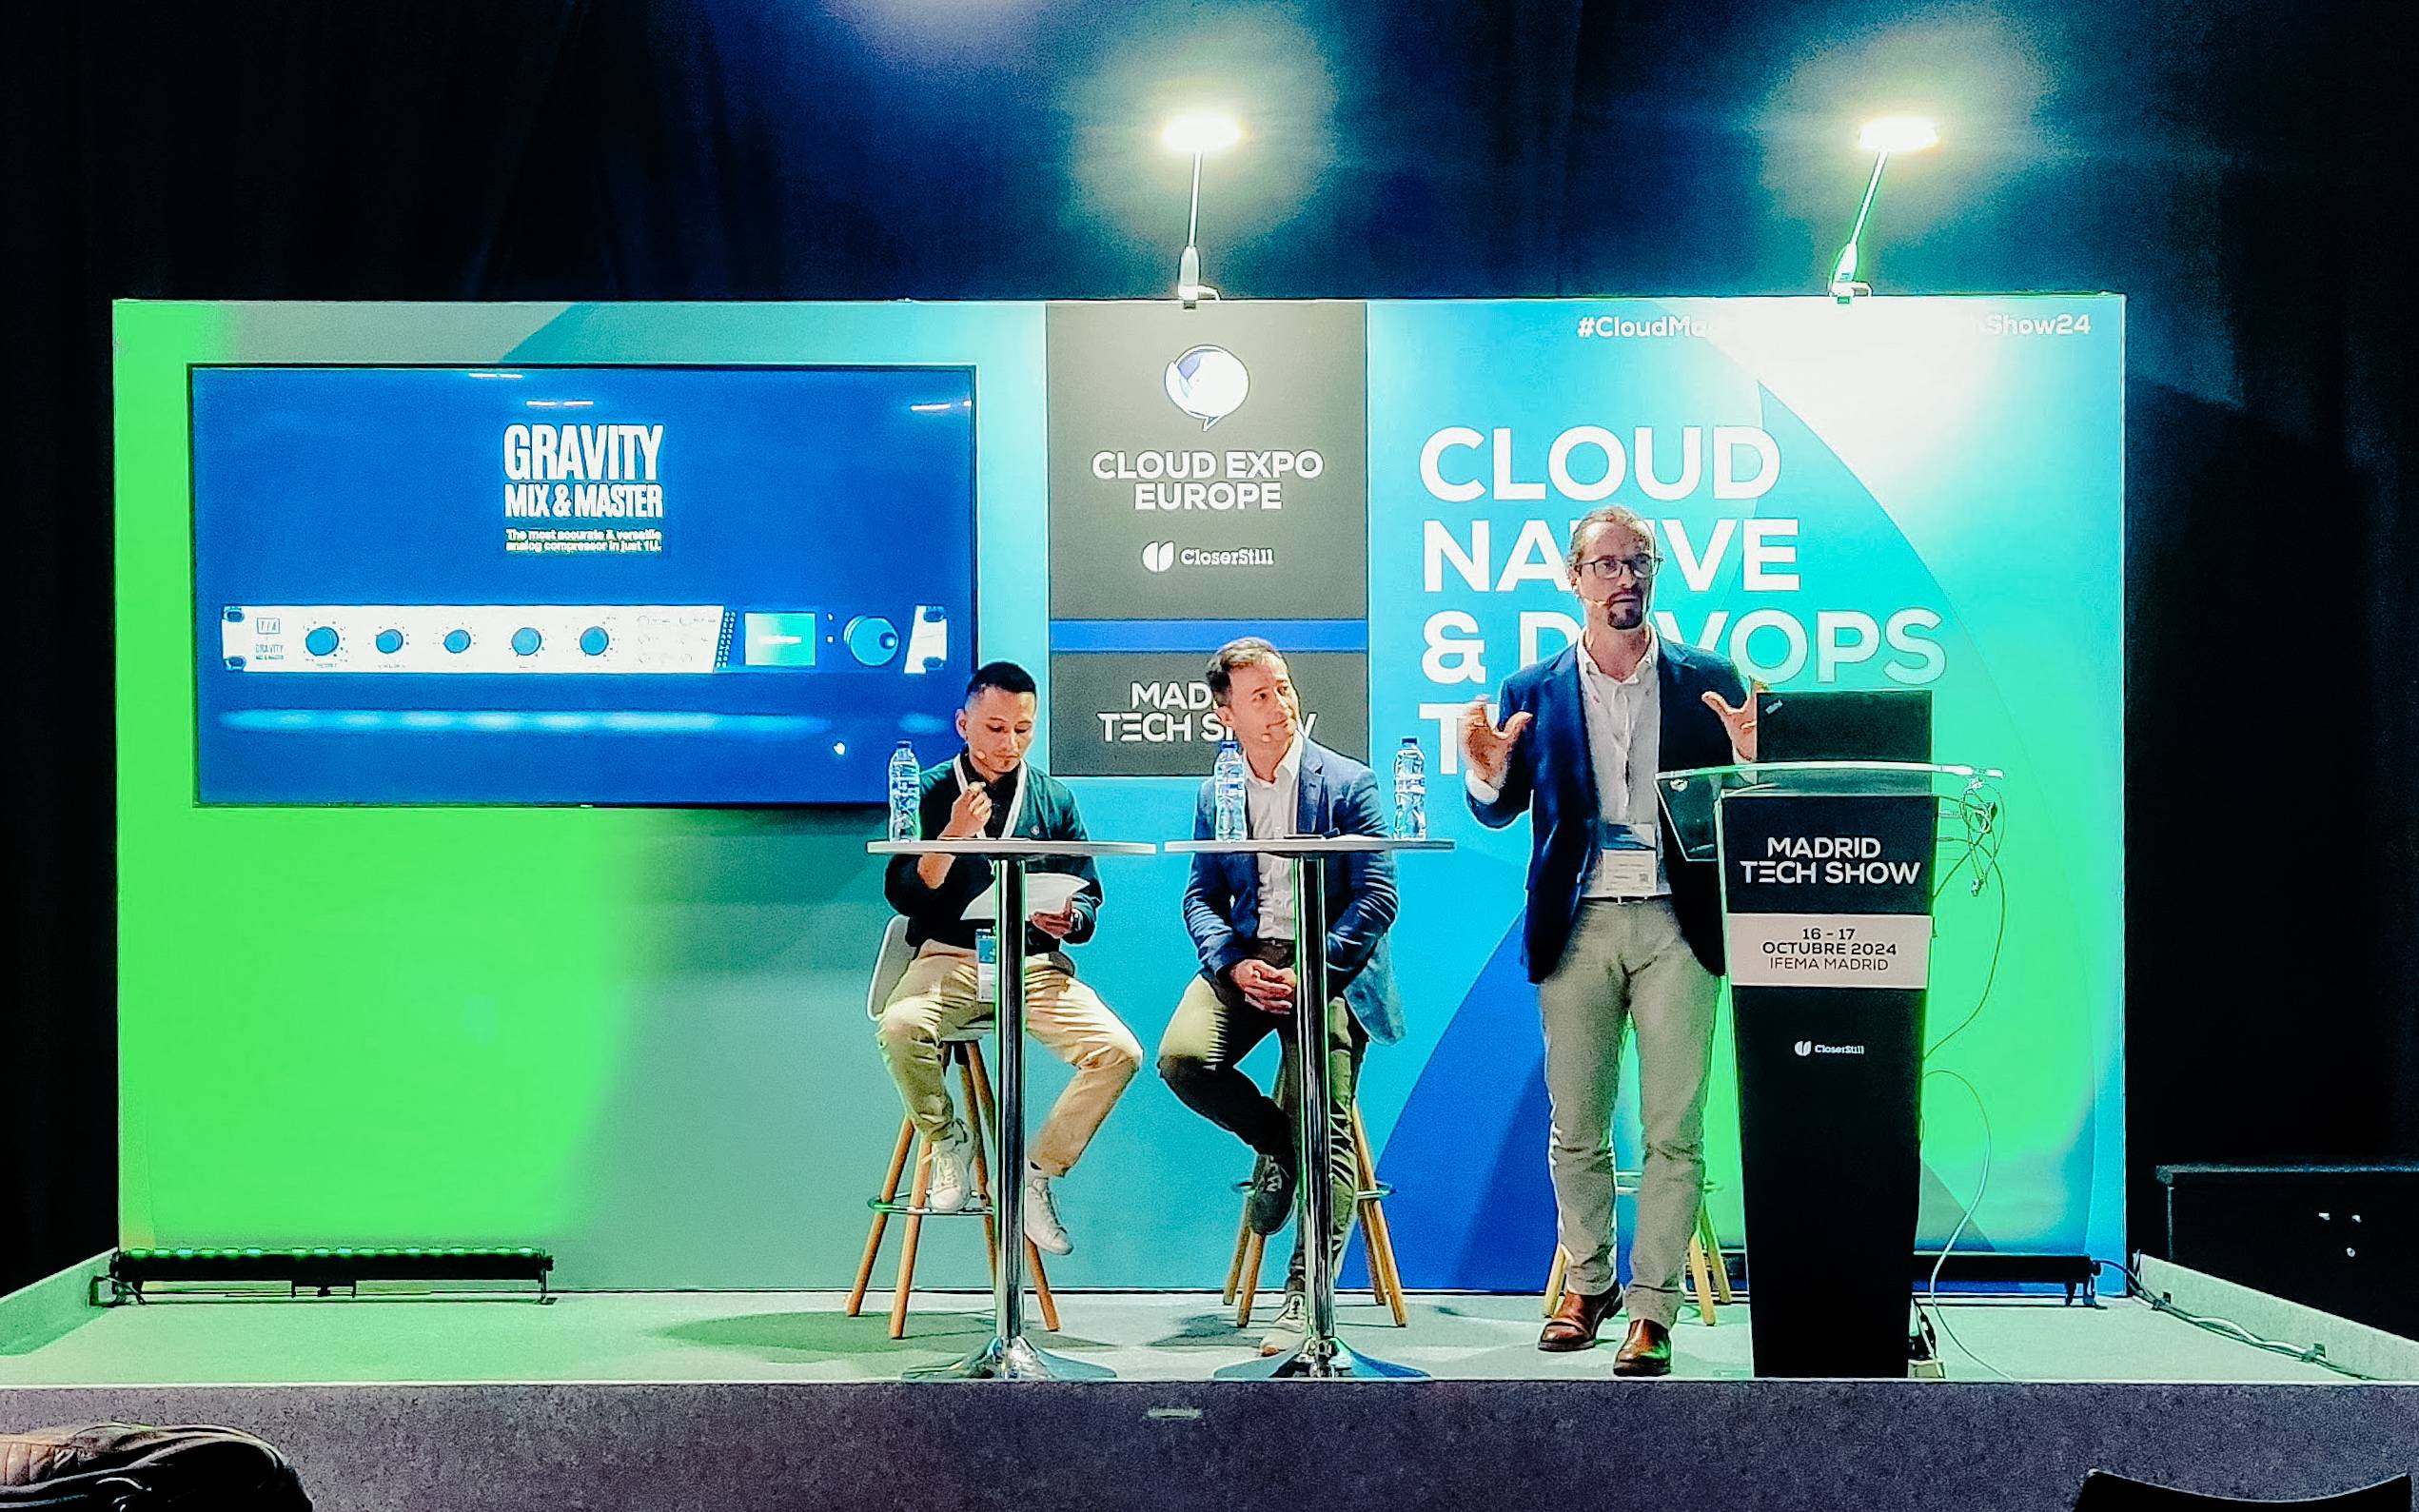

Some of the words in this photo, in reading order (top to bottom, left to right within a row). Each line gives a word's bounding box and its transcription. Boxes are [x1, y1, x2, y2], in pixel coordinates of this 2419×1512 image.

[504, 424, 664, 481] GRAVITY
[1092, 449, 1216, 480] CLOUD
[1226, 448, 1324, 480] EXPO
[1419, 425, 1781, 502] CLOUD
[504, 483, 551, 518] MIX
[552, 483, 573, 518] &
[574, 483, 663, 518] MASTER
[1134, 482, 1282, 510] EUROPE
[506, 529, 527, 541] The
[528, 529, 557, 541] most
[1180, 547, 1275, 565] CloserStill
[1424, 519, 1800, 593] NAVE
[1422, 610, 1486, 684] &
[1131, 682, 1217, 711] MAD
[1096, 712, 1191, 742] TECH
[1767, 836, 1881, 859] MADRID
[1740, 860, 1817, 884] TECH
[1824, 861, 1921, 885] SHOW
[1802, 928, 1821, 940] 16
[1839, 929, 1856, 940] 17
[1762, 941, 1846, 955] OCTUBRE
[1851, 942, 1897, 956] 2024
[1770, 957, 1819, 970] IFEMA
[1824, 958, 1889, 972] MADRID
